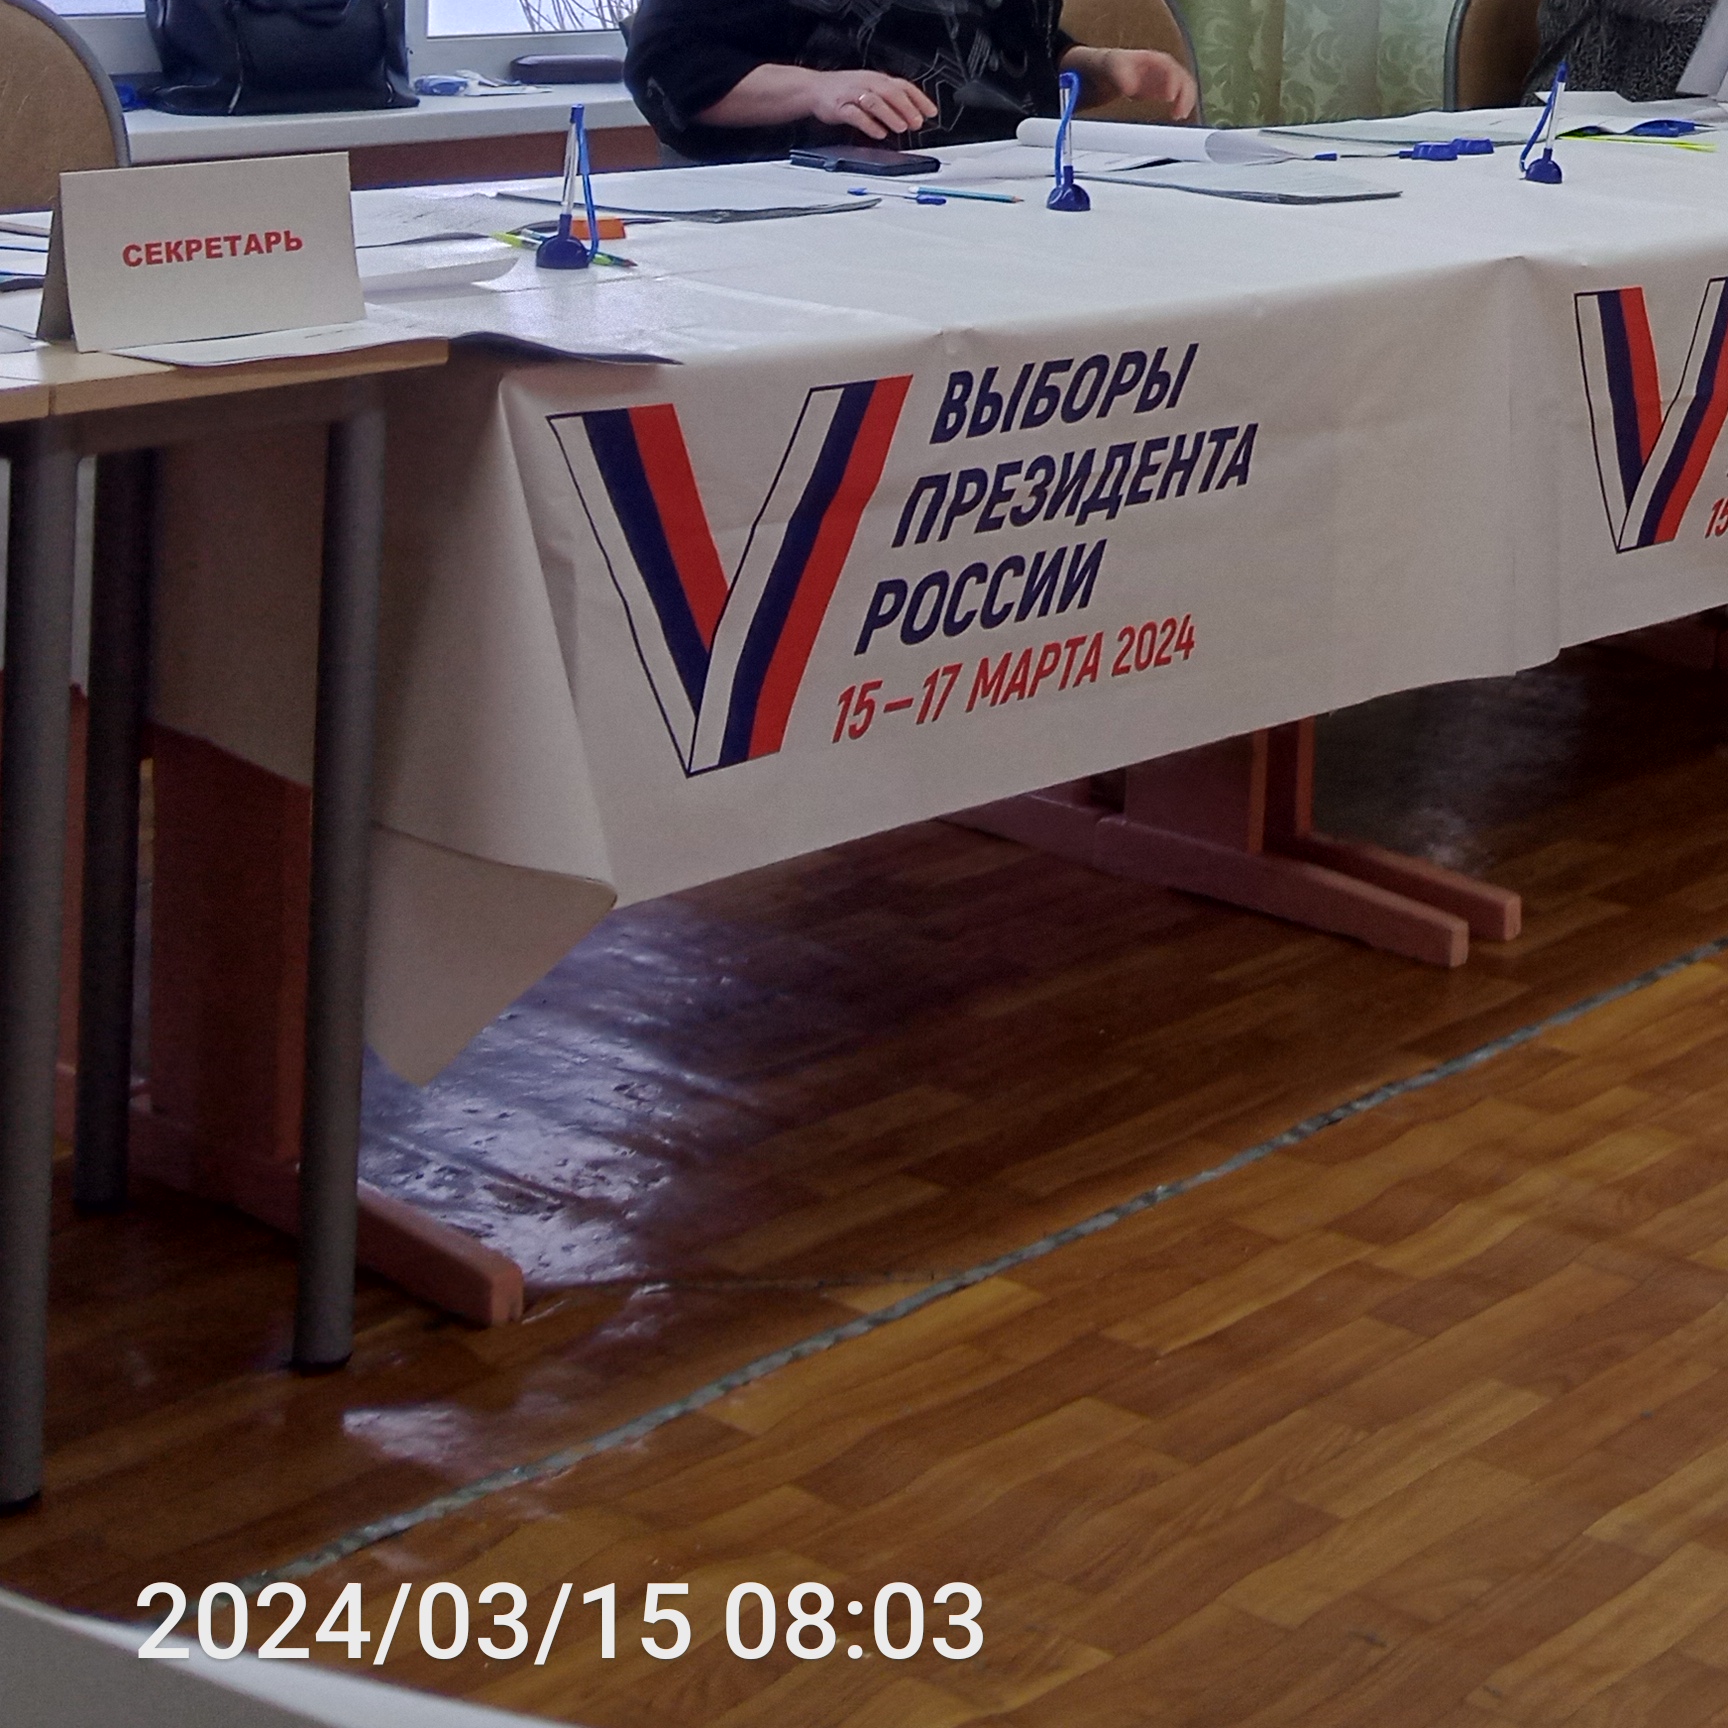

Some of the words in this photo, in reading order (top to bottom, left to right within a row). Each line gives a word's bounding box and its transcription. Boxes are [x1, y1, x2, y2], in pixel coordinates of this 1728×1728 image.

[122, 230, 303, 268] СЕКРЕТАРЬ
[930, 343, 1199, 445] ВЫБОРЫ
[892, 423, 1259, 548] ПРЕЗИДЕНТА
[854, 539, 1106, 656] РОССИИ
[967, 631, 1103, 714] МАРТА
[1111, 614, 1196, 678] 2024
